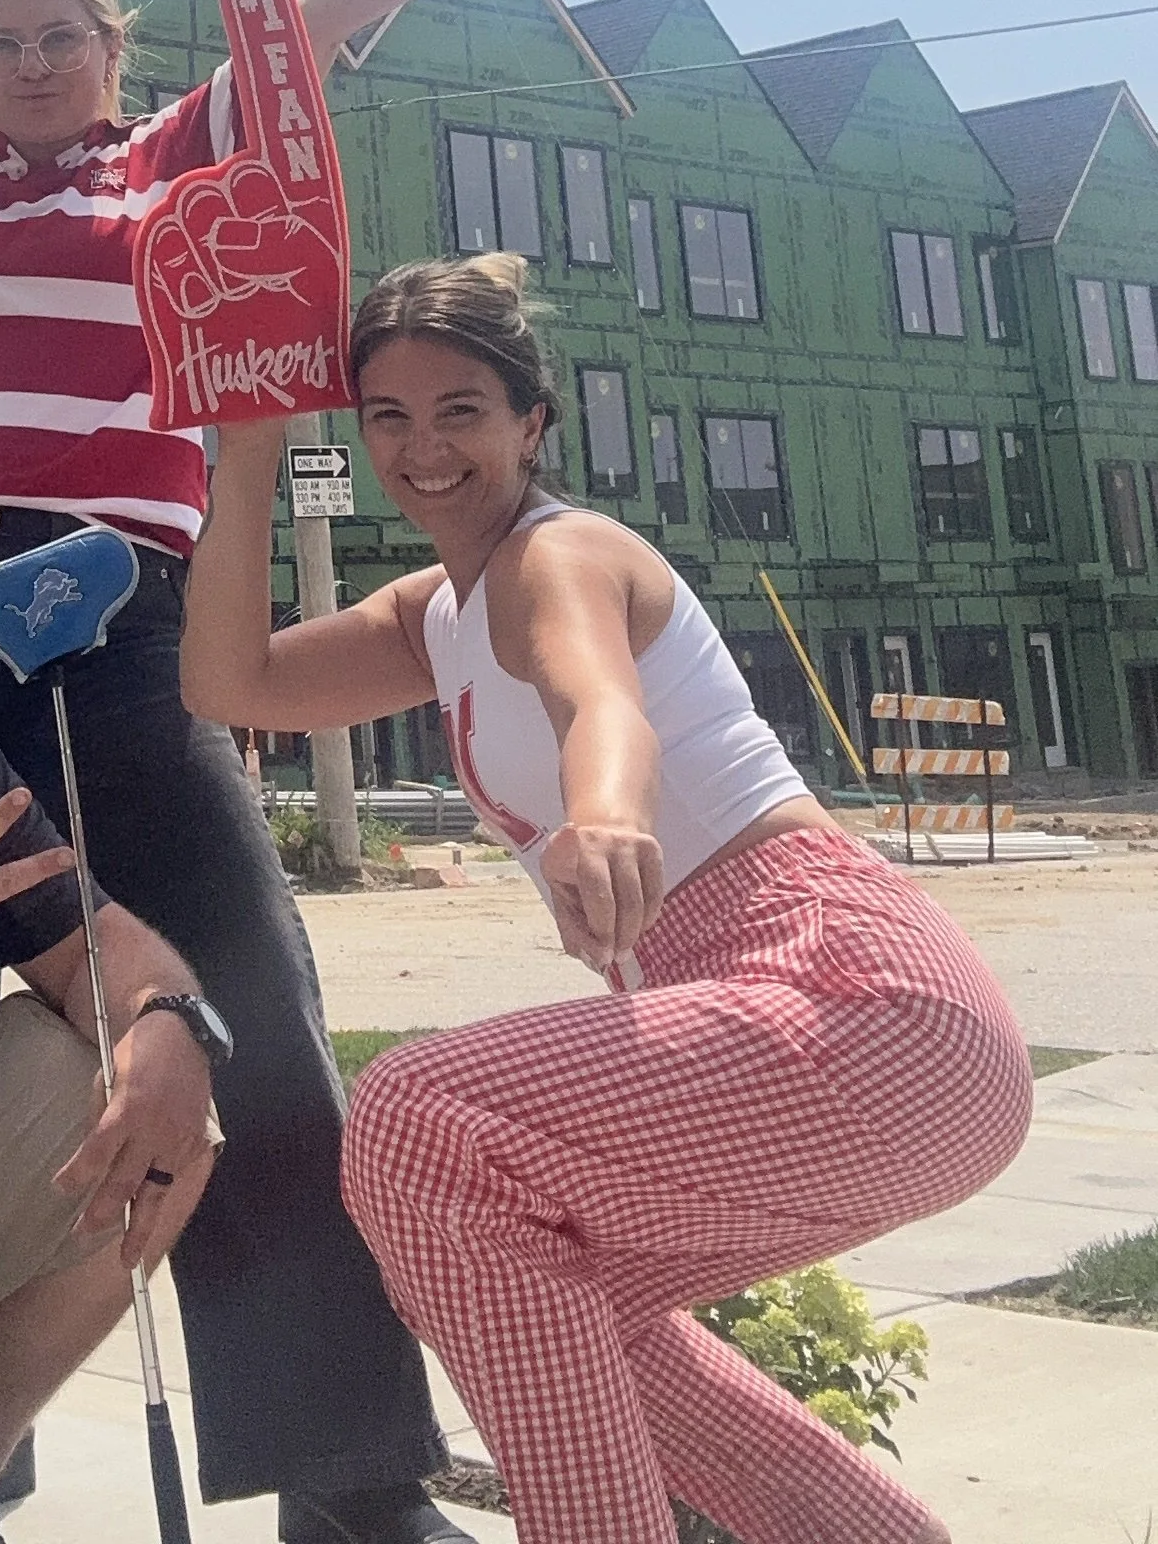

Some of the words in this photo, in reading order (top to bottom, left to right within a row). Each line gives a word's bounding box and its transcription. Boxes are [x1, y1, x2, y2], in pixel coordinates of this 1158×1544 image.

[262, 42, 321, 183] FAN
[177, 323, 332, 416] Huskers
[297, 458, 313, 469] ONE
[317, 457, 333, 468] WAY
[310, 480, 320, 490] AM
[342, 480, 350, 490] AM
[310, 493, 320, 503] PM
[342, 491, 352, 502] PM
[302, 504, 327, 515] SCHOOL
[332, 503, 348, 514] DAYS
